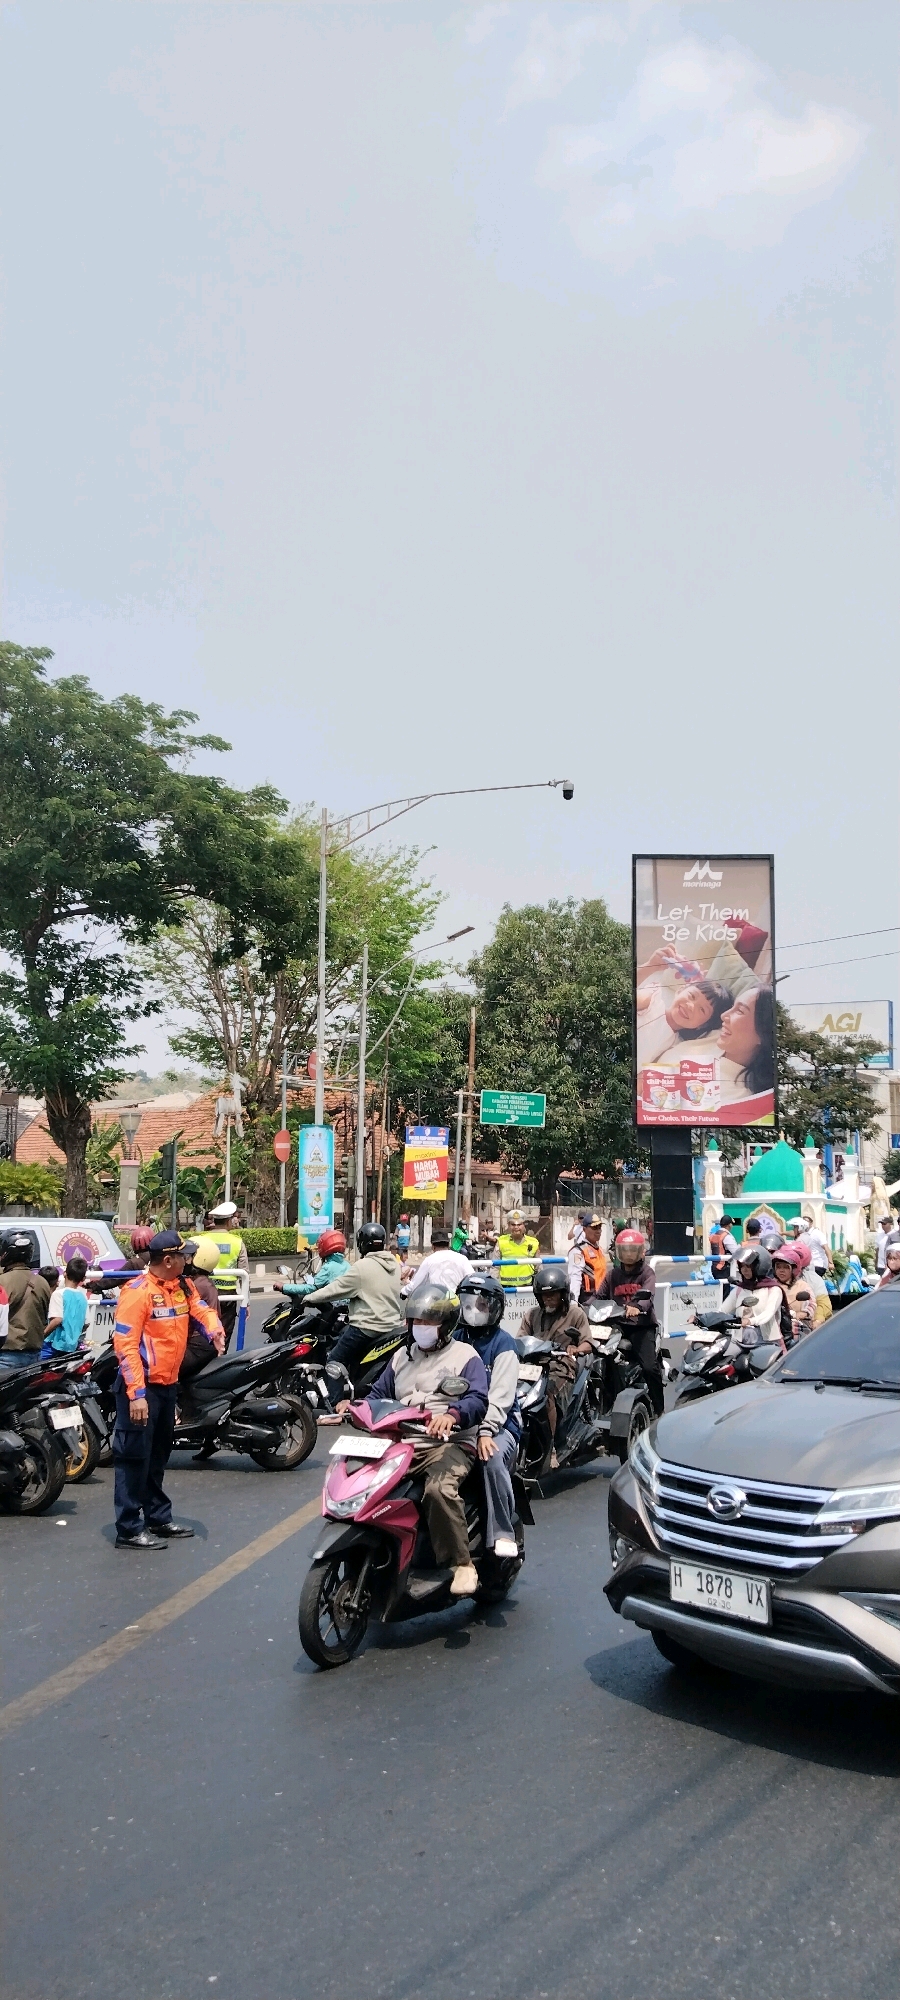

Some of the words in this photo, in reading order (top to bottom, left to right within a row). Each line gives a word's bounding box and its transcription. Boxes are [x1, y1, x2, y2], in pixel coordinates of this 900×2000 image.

[682, 880, 721, 889] morinaga
[657, 904, 693, 921] Let
[699, 903, 749, 921] Them
[662, 923, 690, 941] Be
[696, 923, 738, 942] Kids
[817, 1012, 862, 1033] AGI
[413, 1160, 439, 1172] HARGA
[415, 1169, 440, 1182] MURAH
[674, 1566, 682, 1587] H
[697, 1571, 733, 1599] 1878
[746, 1581, 764, 1608] VX
